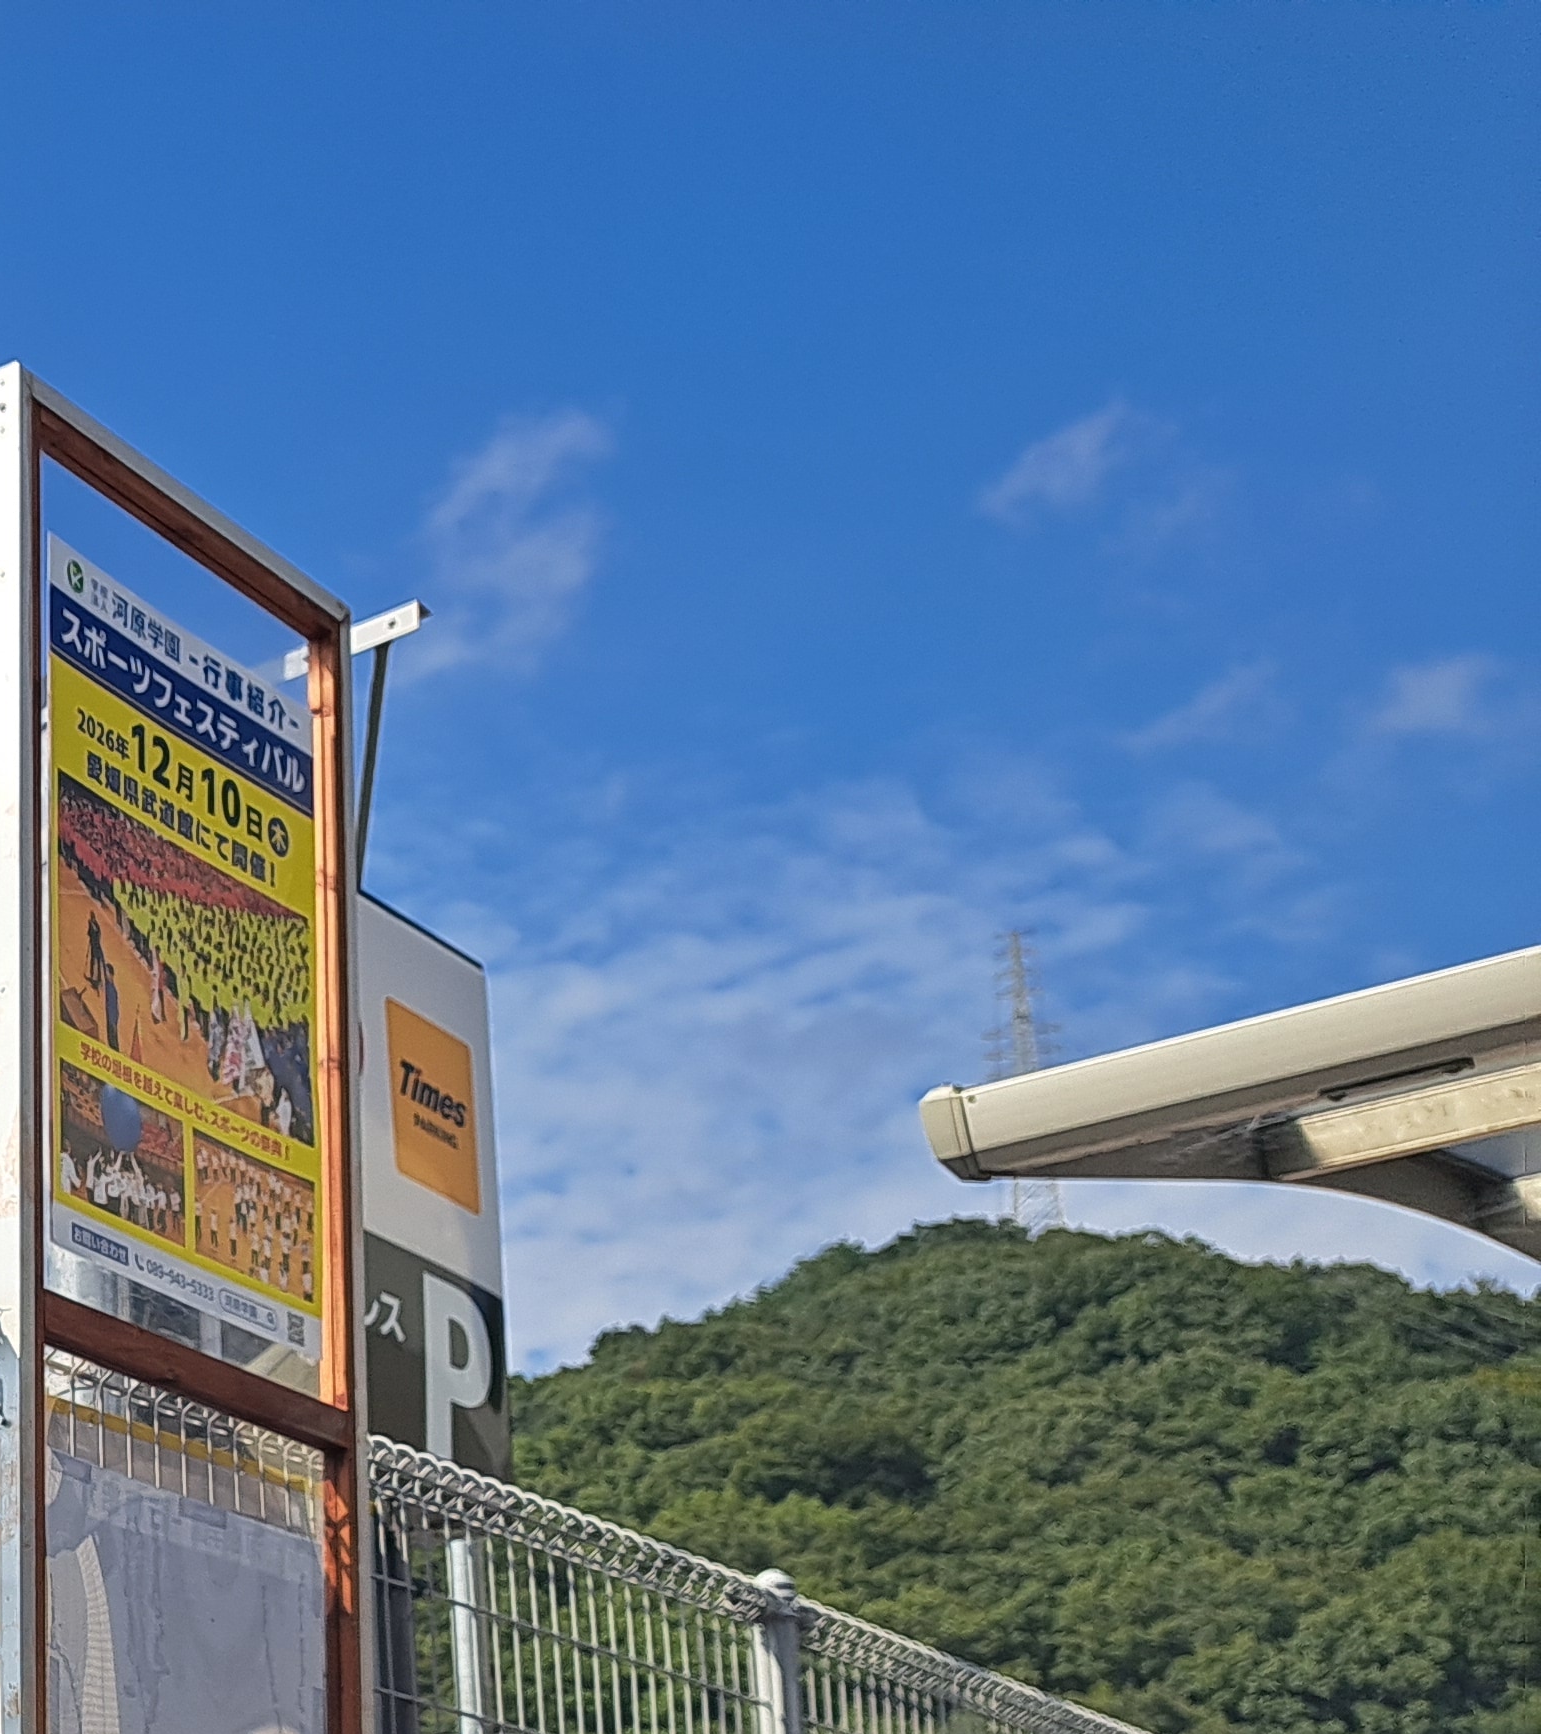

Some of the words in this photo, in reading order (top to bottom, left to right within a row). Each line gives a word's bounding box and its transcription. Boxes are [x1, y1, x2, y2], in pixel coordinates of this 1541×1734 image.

[112, 591, 180, 663] 河原学園
[61, 608, 306, 794] スポーツフェスティバル
[400, 1059, 466, 1128] Times
[423, 1270, 492, 1462] P
